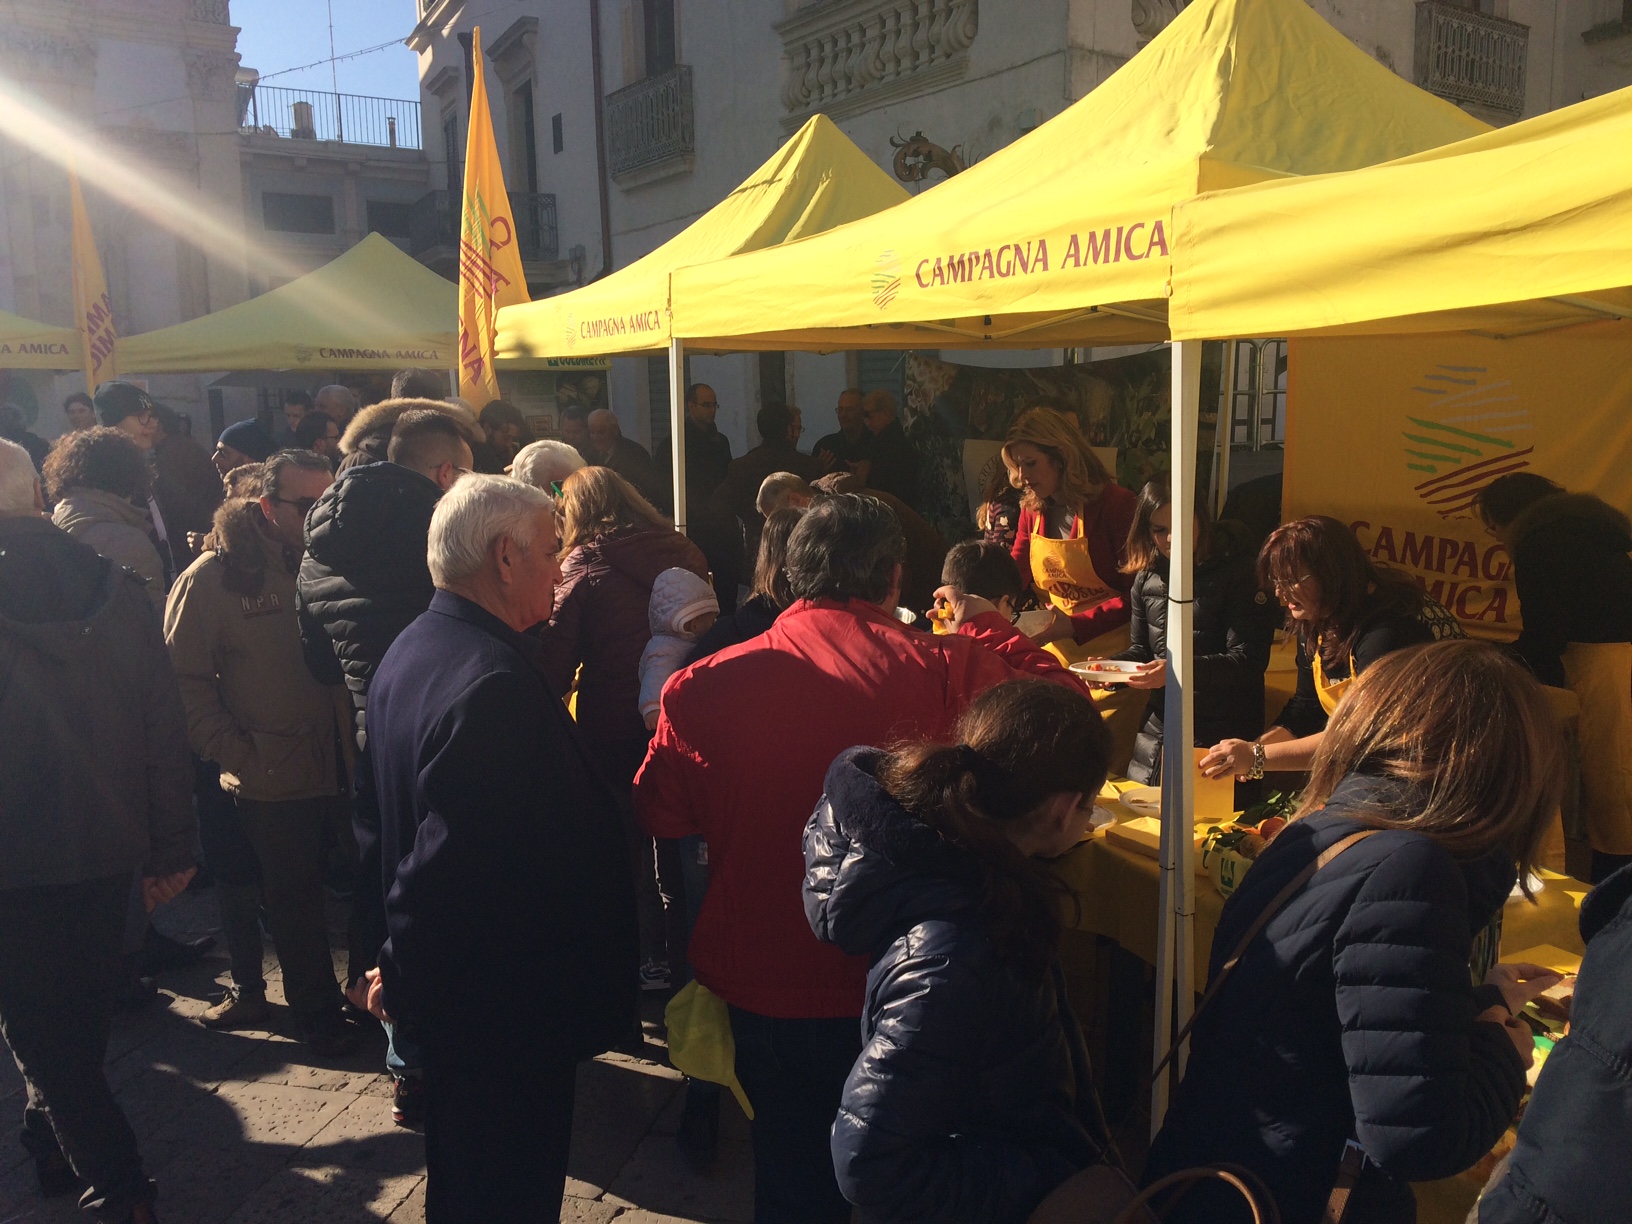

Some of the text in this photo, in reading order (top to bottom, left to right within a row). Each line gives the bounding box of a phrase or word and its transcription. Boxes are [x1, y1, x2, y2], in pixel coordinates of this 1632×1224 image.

[915, 220, 1169, 289] CAMPAGNA AMICA
[580, 310, 661, 339] CAMPAGNA AMICA
[17, 343, 70, 354] AMICA
[319, 347, 439, 360] CAMPAGNA AMICA
[1351, 520, 1512, 581] CAMPAG
[1415, 575, 1508, 623] MICA
